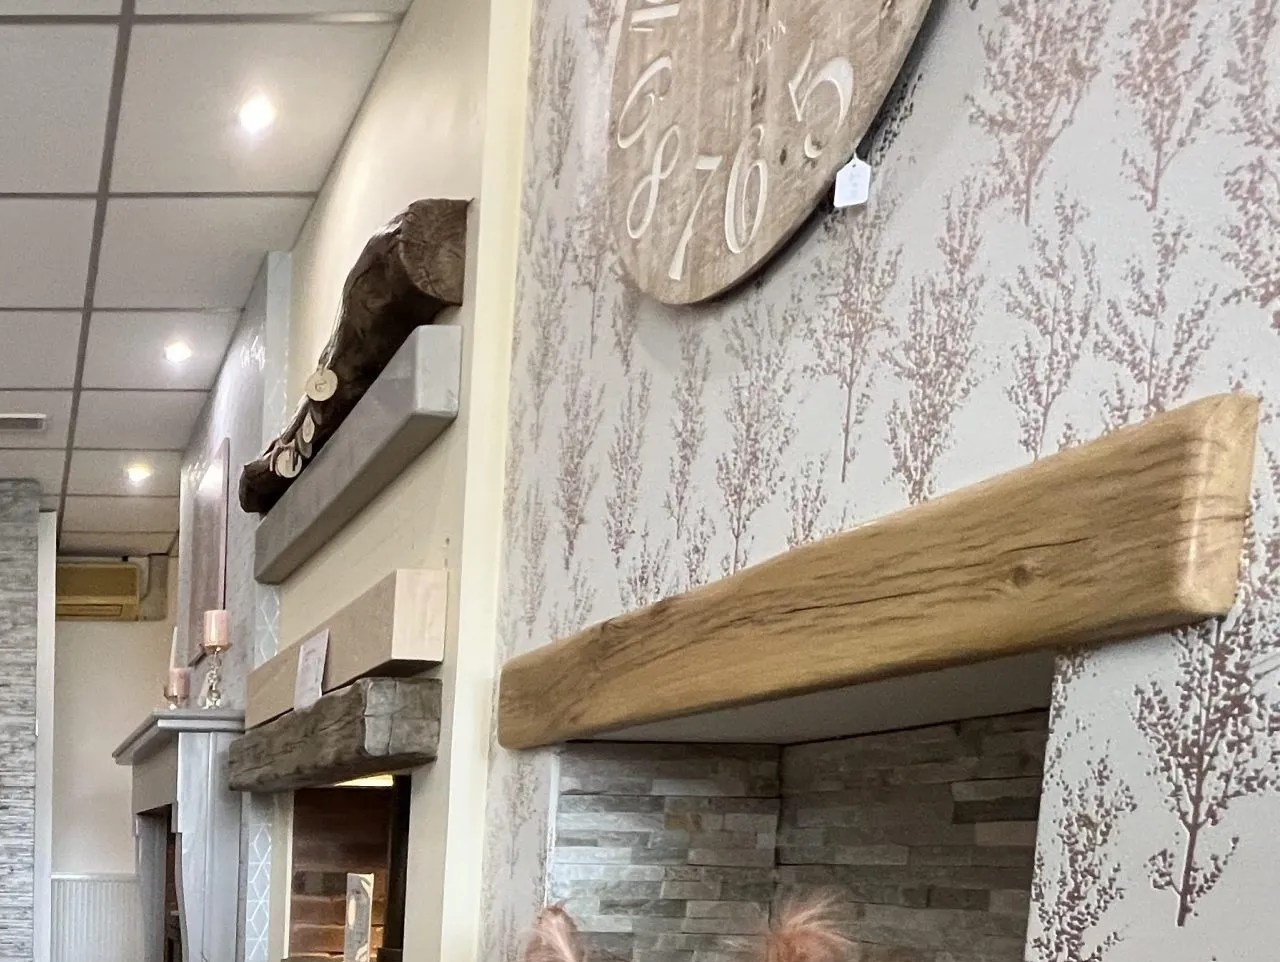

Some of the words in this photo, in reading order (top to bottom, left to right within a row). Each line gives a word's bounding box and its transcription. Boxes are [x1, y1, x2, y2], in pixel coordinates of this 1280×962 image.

[788, 39, 854, 159] 5
[626, 125, 680, 239] 8
[669, 154, 723, 281] 7
[724, 123, 768, 254] 6
